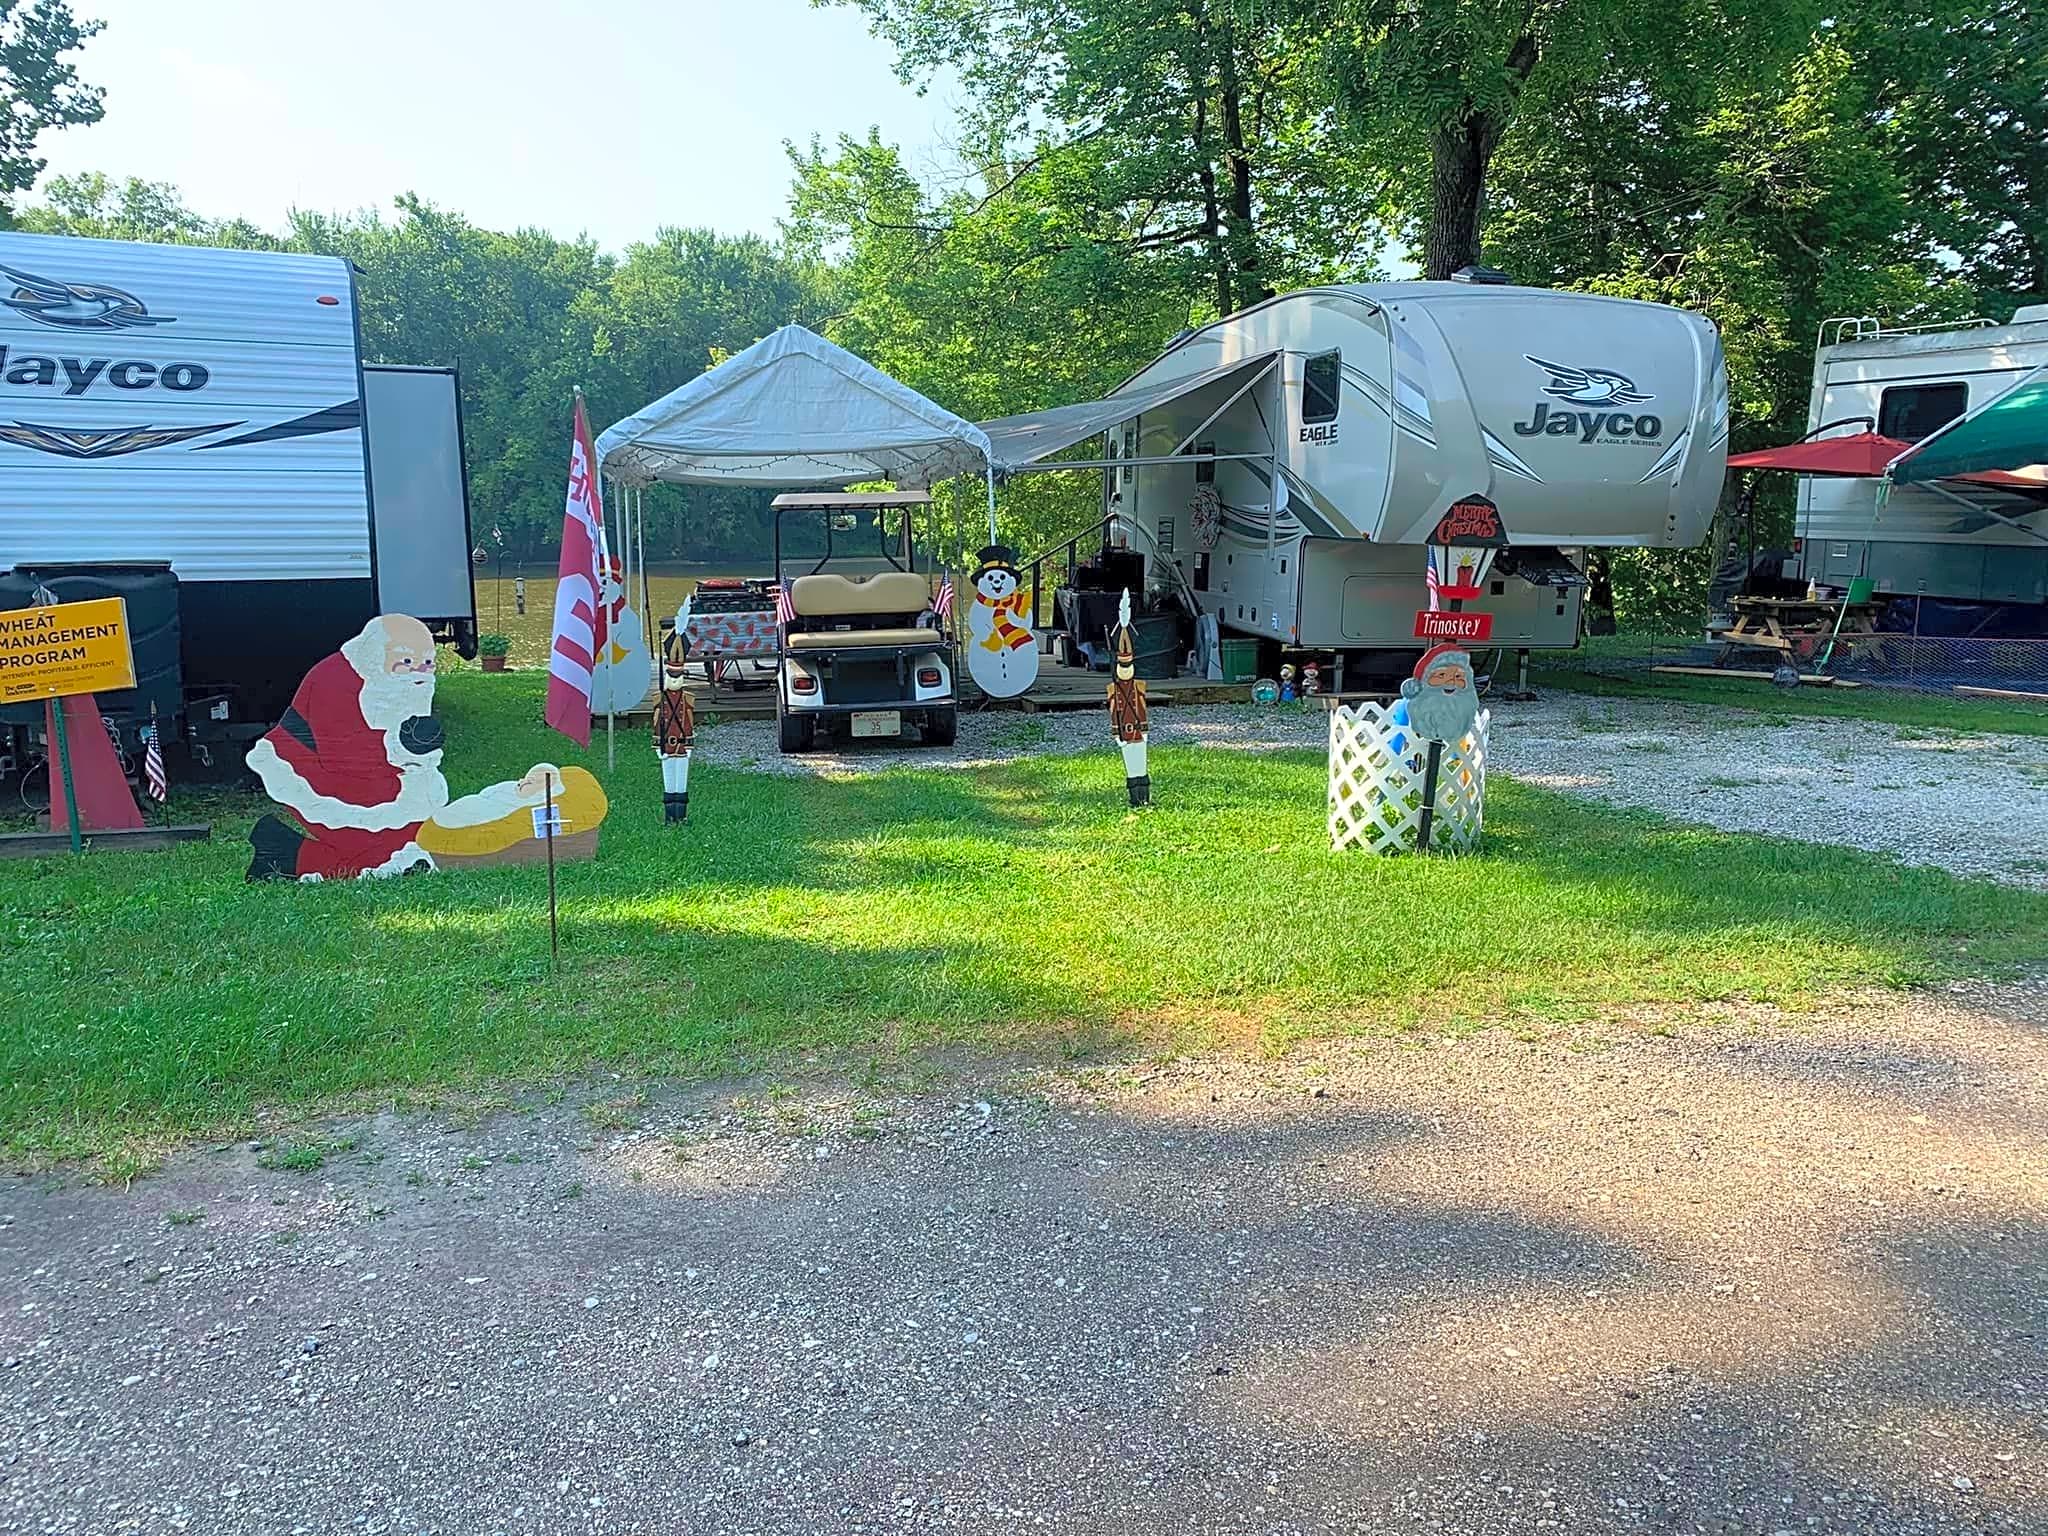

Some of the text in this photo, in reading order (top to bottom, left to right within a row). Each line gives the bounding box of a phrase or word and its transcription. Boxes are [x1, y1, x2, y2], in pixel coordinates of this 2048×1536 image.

[0, 344, 210, 395] ayco
[1299, 424, 1339, 442] EAGLE
[1513, 402, 1662, 444] Jayco
[1596, 438, 1662, 448] EAGLE SERIES
[0, 647, 86, 669] PROGRAM
[81, 660, 115, 670] EFFICIENT
